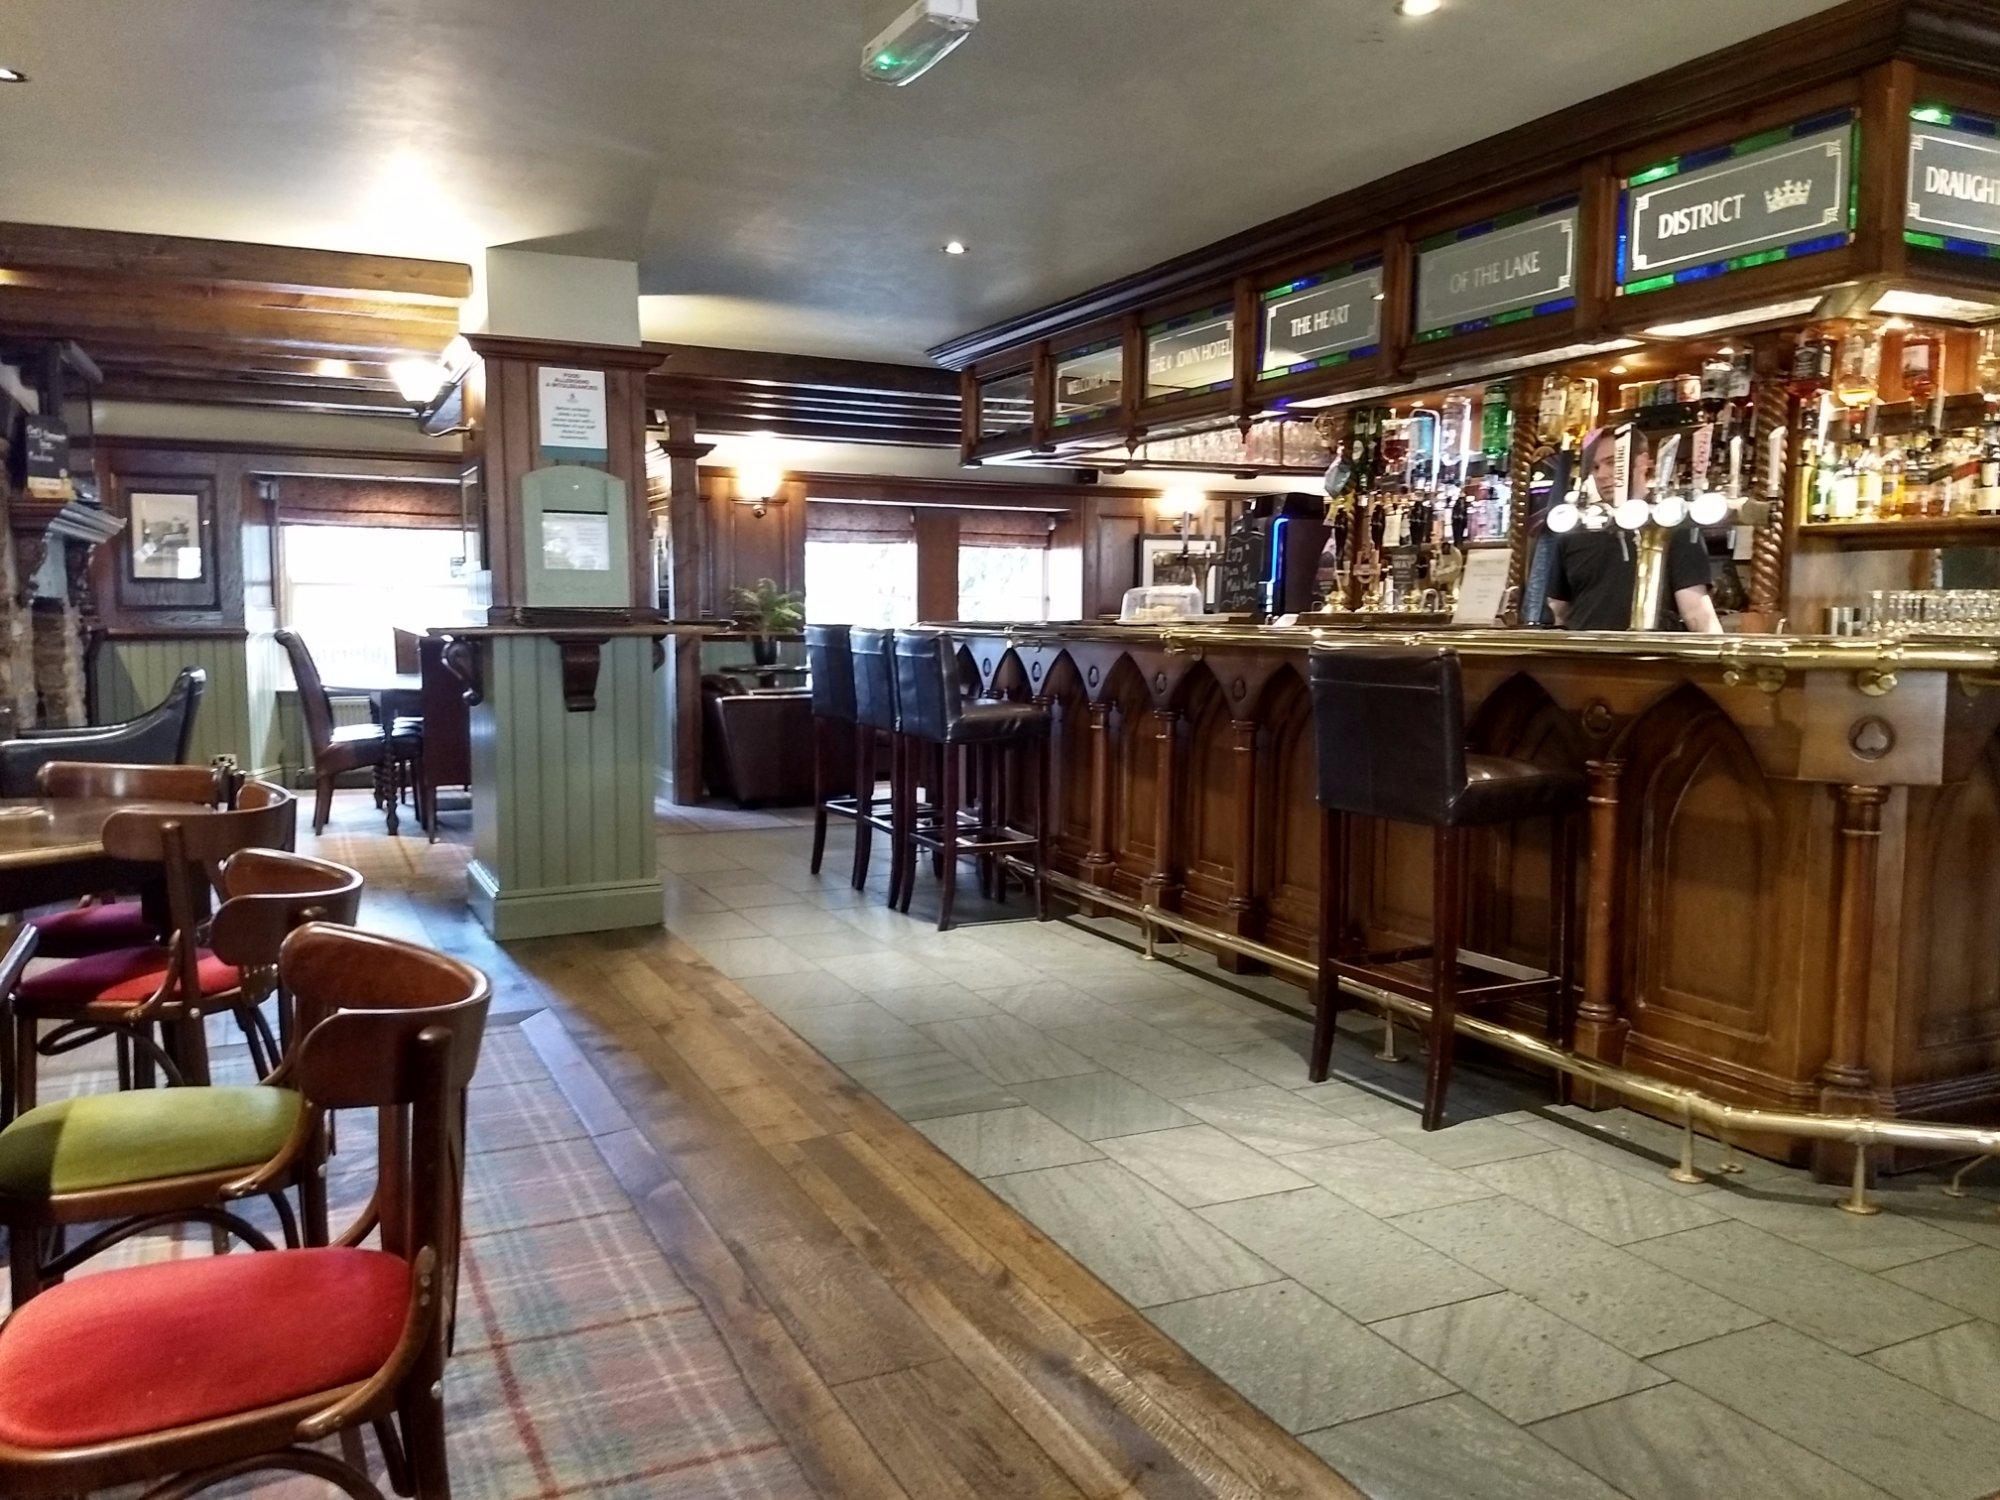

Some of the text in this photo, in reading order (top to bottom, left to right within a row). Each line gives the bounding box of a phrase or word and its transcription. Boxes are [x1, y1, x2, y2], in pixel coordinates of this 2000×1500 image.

[1658, 194, 1745, 239] DISTRICT
[1450, 251, 1541, 293] OF THE LAKE
[1290, 304, 1350, 337] THE HEART
[1202, 338, 1232, 360] HOTEL
[1615, 445, 1625, 488] CARLING
